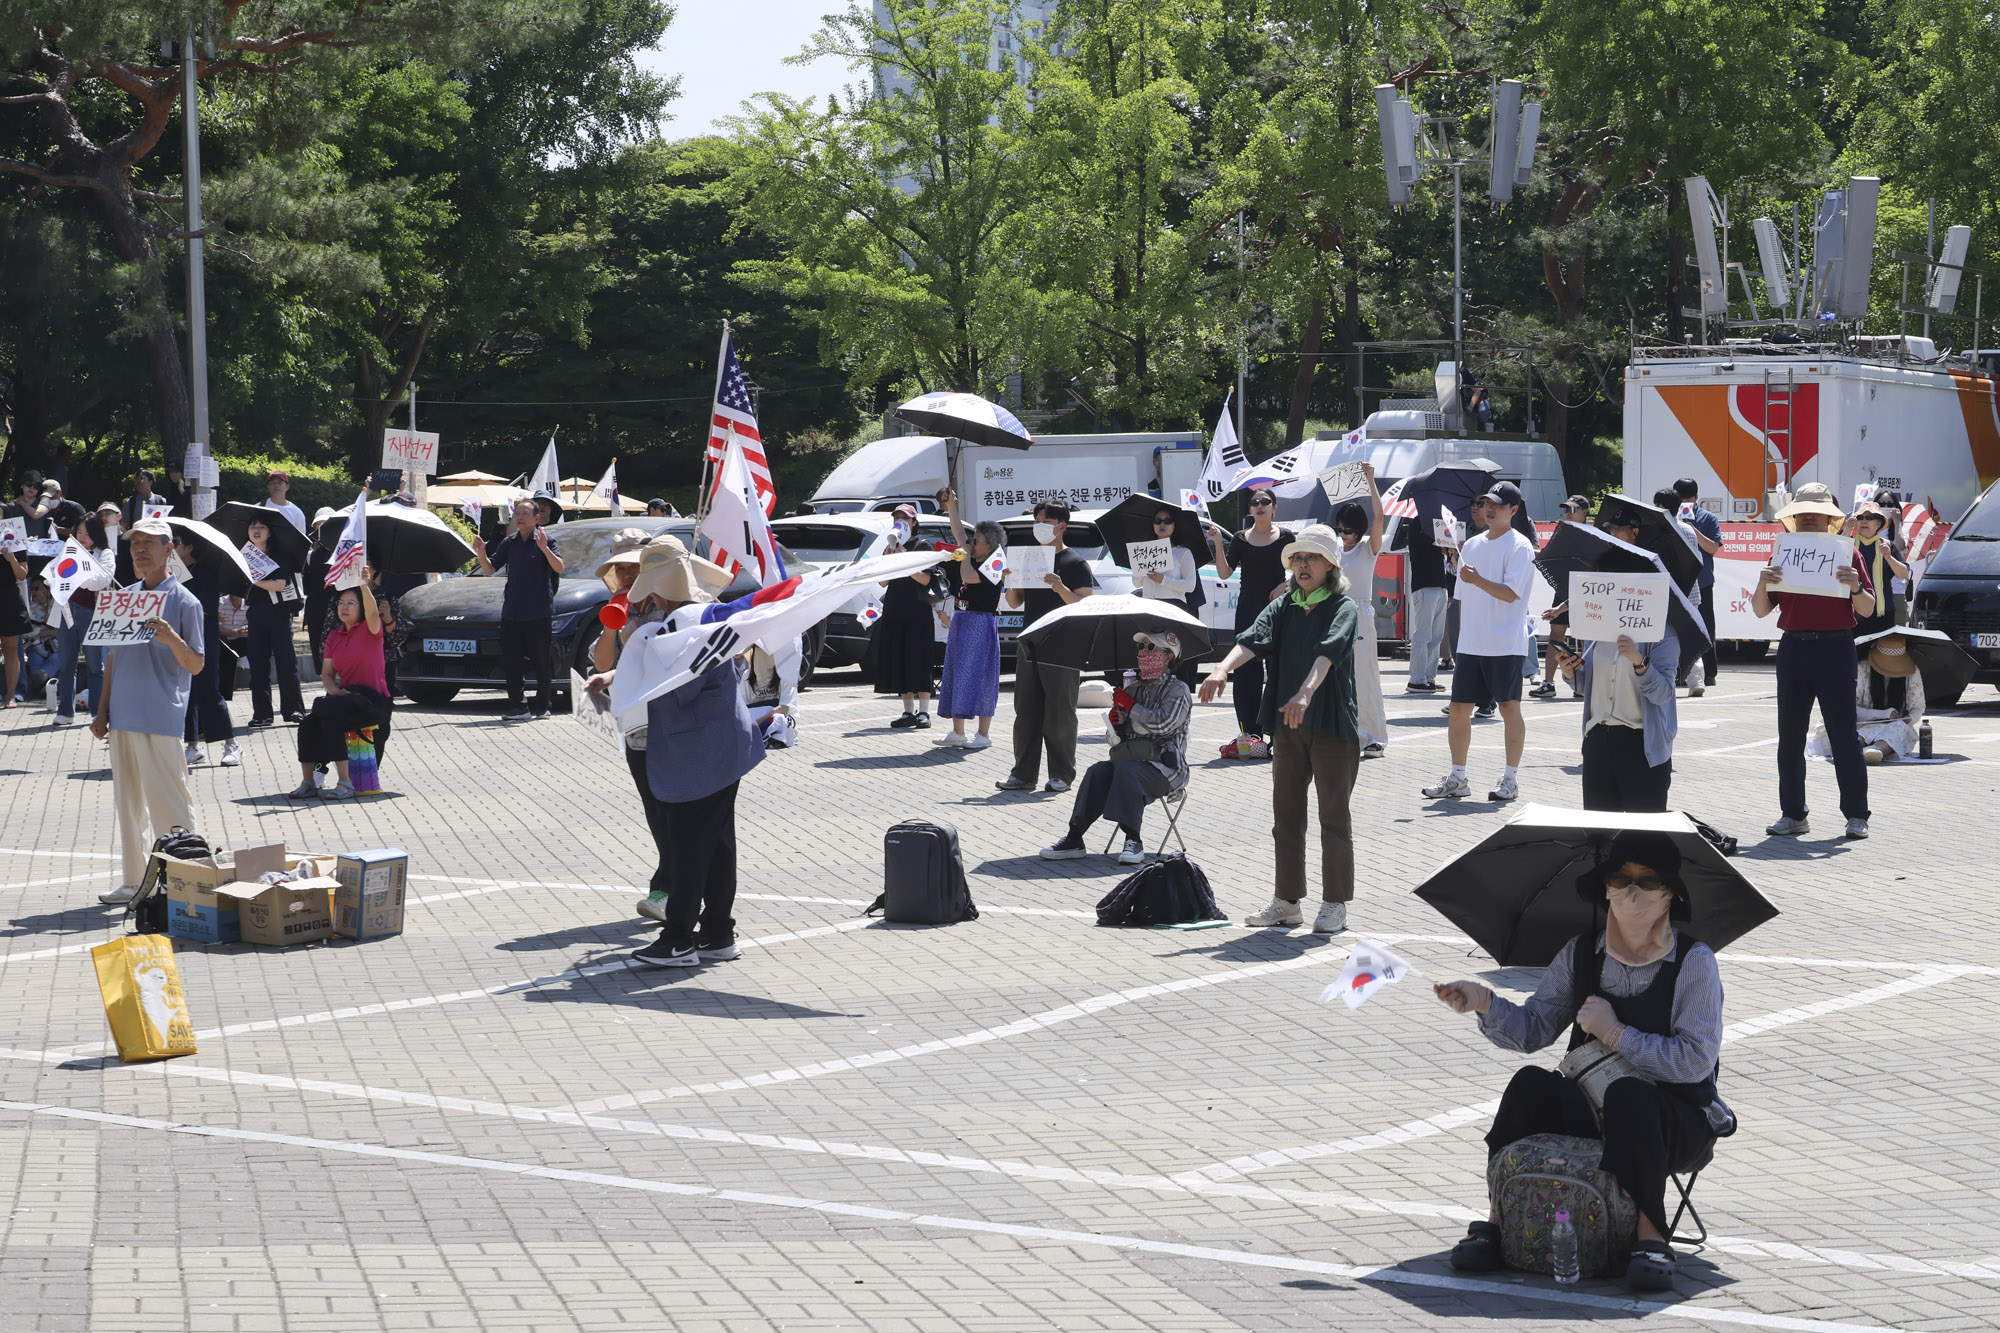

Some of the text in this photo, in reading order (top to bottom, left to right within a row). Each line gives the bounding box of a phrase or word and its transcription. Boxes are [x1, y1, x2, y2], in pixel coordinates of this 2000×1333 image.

[388, 436, 433, 460] 재선거
[983, 490, 1025, 506] 종합음료
[1070, 488, 1090, 503] 전문
[1093, 486, 1131, 502] 유통기업
[1738, 531, 1753, 541] 긴급
[1133, 546, 1168, 561] 부정선거
[1723, 543, 1771, 553] 안전에 유의해
[1138, 560, 1167, 572] 재선거
[1781, 548, 1836, 576] 재선거
[1582, 581, 1615, 595] STOP
[97, 592, 167, 618] 부정선거
[1617, 598, 1643, 612] THE
[1730, 601, 1747, 613] SK
[1619, 616, 1653, 628] STEAL
[449, 641, 472, 652] 7624
[169, 1024, 194, 1039] SAVE
